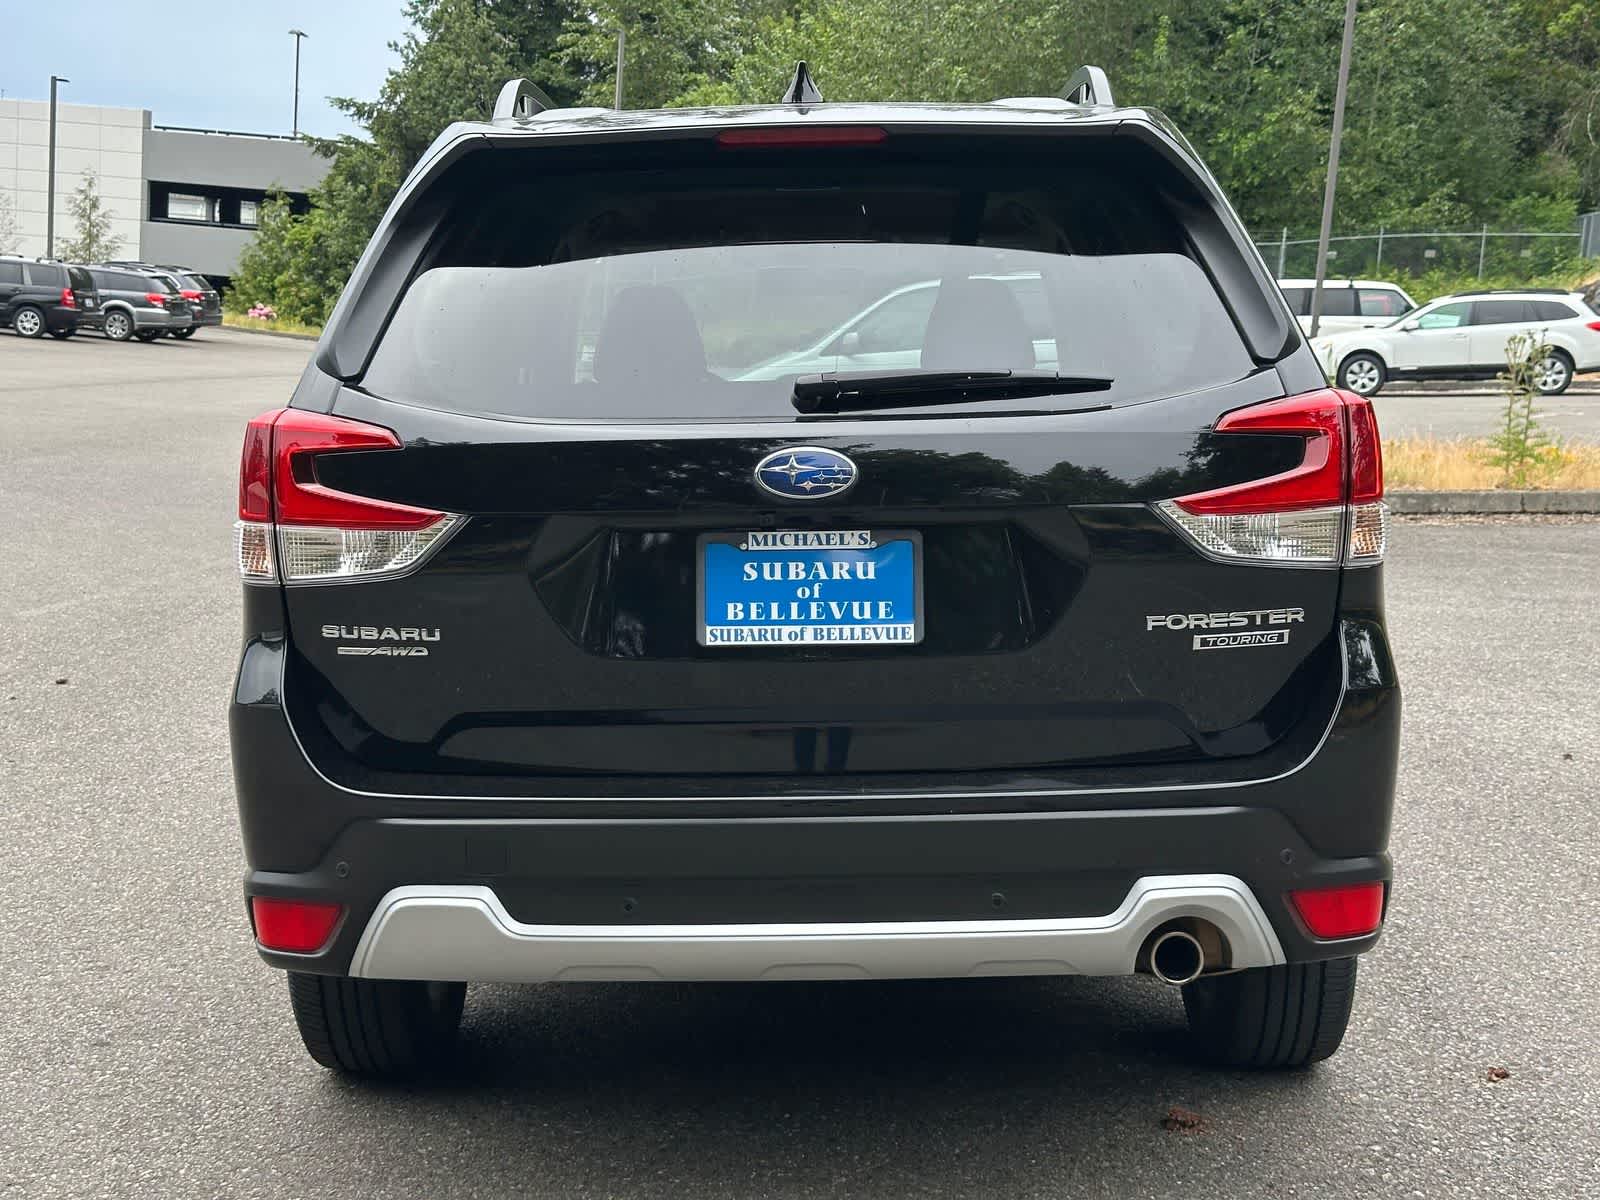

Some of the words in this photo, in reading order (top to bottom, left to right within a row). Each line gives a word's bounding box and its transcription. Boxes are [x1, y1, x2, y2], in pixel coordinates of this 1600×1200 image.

[750, 532, 870, 547] MICHAEL'S
[743, 561, 876, 581] SUBARU
[797, 583, 822, 599] of
[726, 601, 895, 621] BELLEVUE
[1146, 608, 1305, 631] FORESTER
[321, 624, 441, 641] SUBARU
[709, 627, 782, 643] SUBARU
[788, 627, 807, 641] of
[813, 626, 913, 641] BELLEVUE
[1206, 633, 1279, 647] TOURING
[370, 646, 429, 656] AWD
